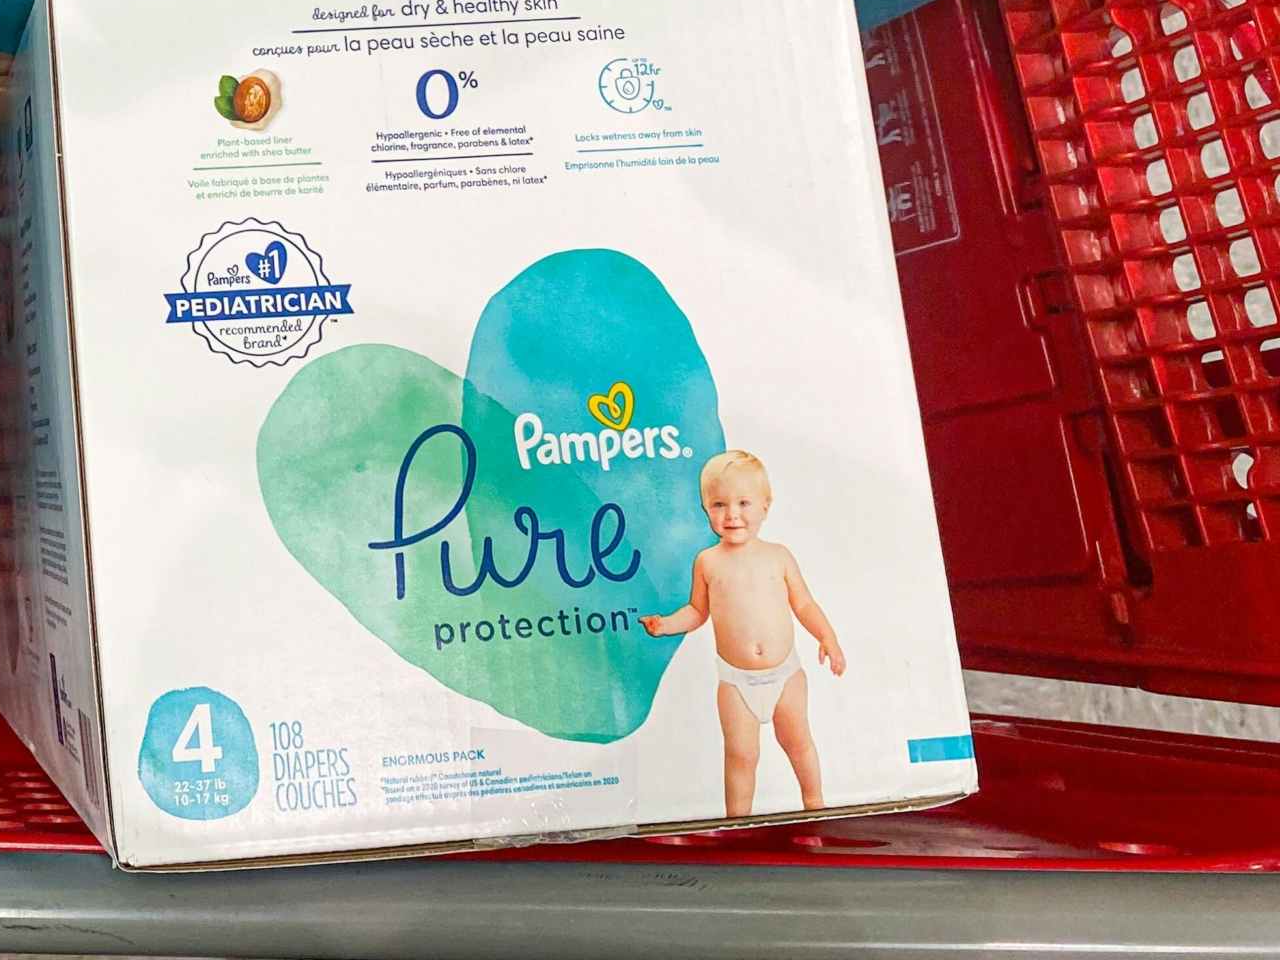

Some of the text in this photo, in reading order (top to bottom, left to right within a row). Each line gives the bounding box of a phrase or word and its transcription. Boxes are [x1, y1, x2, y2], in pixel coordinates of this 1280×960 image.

[312, 6, 369, 23] designed
[370, 5, 396, 21] for
[401, 0, 430, 20] dry
[435, 0, 449, 14] &
[252, 27, 625, 58] conçues pour la peau sèche et la peau saine
[633, 63, 661, 76] 12hr
[416, 69, 478, 119] 0%
[217, 137, 271, 147] Plant-based
[376, 126, 526, 141] Hypoallergenic Free elemental
[575, 131, 661, 143] Locks wetness away
[200, 146, 312, 160] enriched butter
[458, 139, 499, 150] parabens
[385, 165, 526, 180] Hypoallergéniques Sans chlore
[565, 161, 614, 172] Emprisonne
[207, 249, 281, 287] Pampers #1
[175, 291, 342, 318] PEDIATRICIAN
[219, 319, 303, 336] recommended
[243, 334, 282, 350] brand
[368, 424, 641, 600] Pure
[172, 703, 224, 773] 4
[269, 720, 304, 750] 108
[273, 748, 350, 781] DIAPERS
[382, 749, 485, 767] ENORMOUS PACK
[174, 779, 226, 793] 22-37 lb
[276, 777, 358, 812] COUCHES
[174, 792, 230, 806] 10-17 kg
